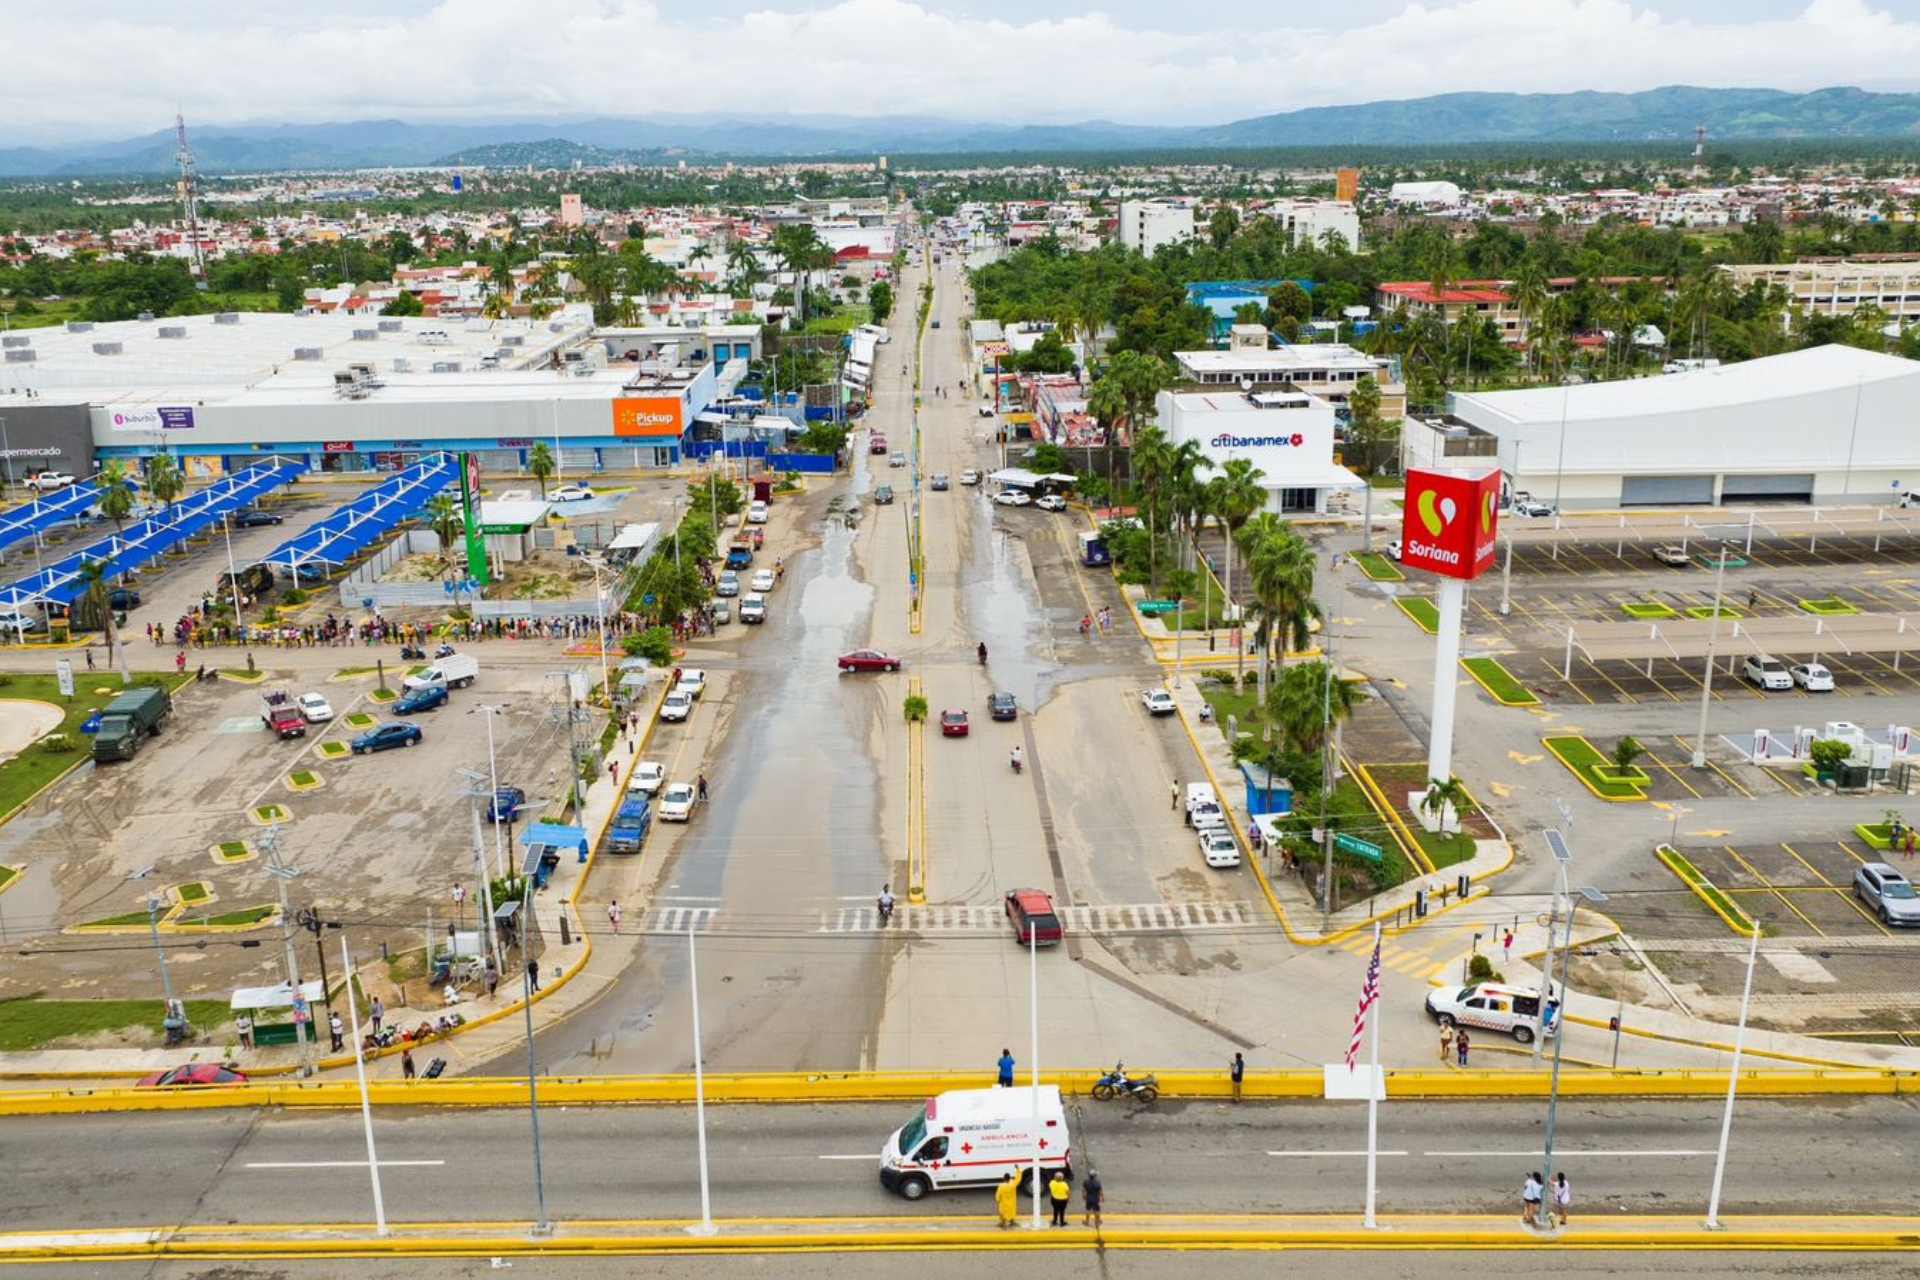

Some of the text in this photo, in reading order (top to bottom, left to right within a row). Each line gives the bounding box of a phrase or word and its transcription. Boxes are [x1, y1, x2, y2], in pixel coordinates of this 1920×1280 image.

[636, 412, 673, 424] Pickup
[1211, 434, 1289, 448] citibanamex
[1408, 539, 1459, 565] Soriana
